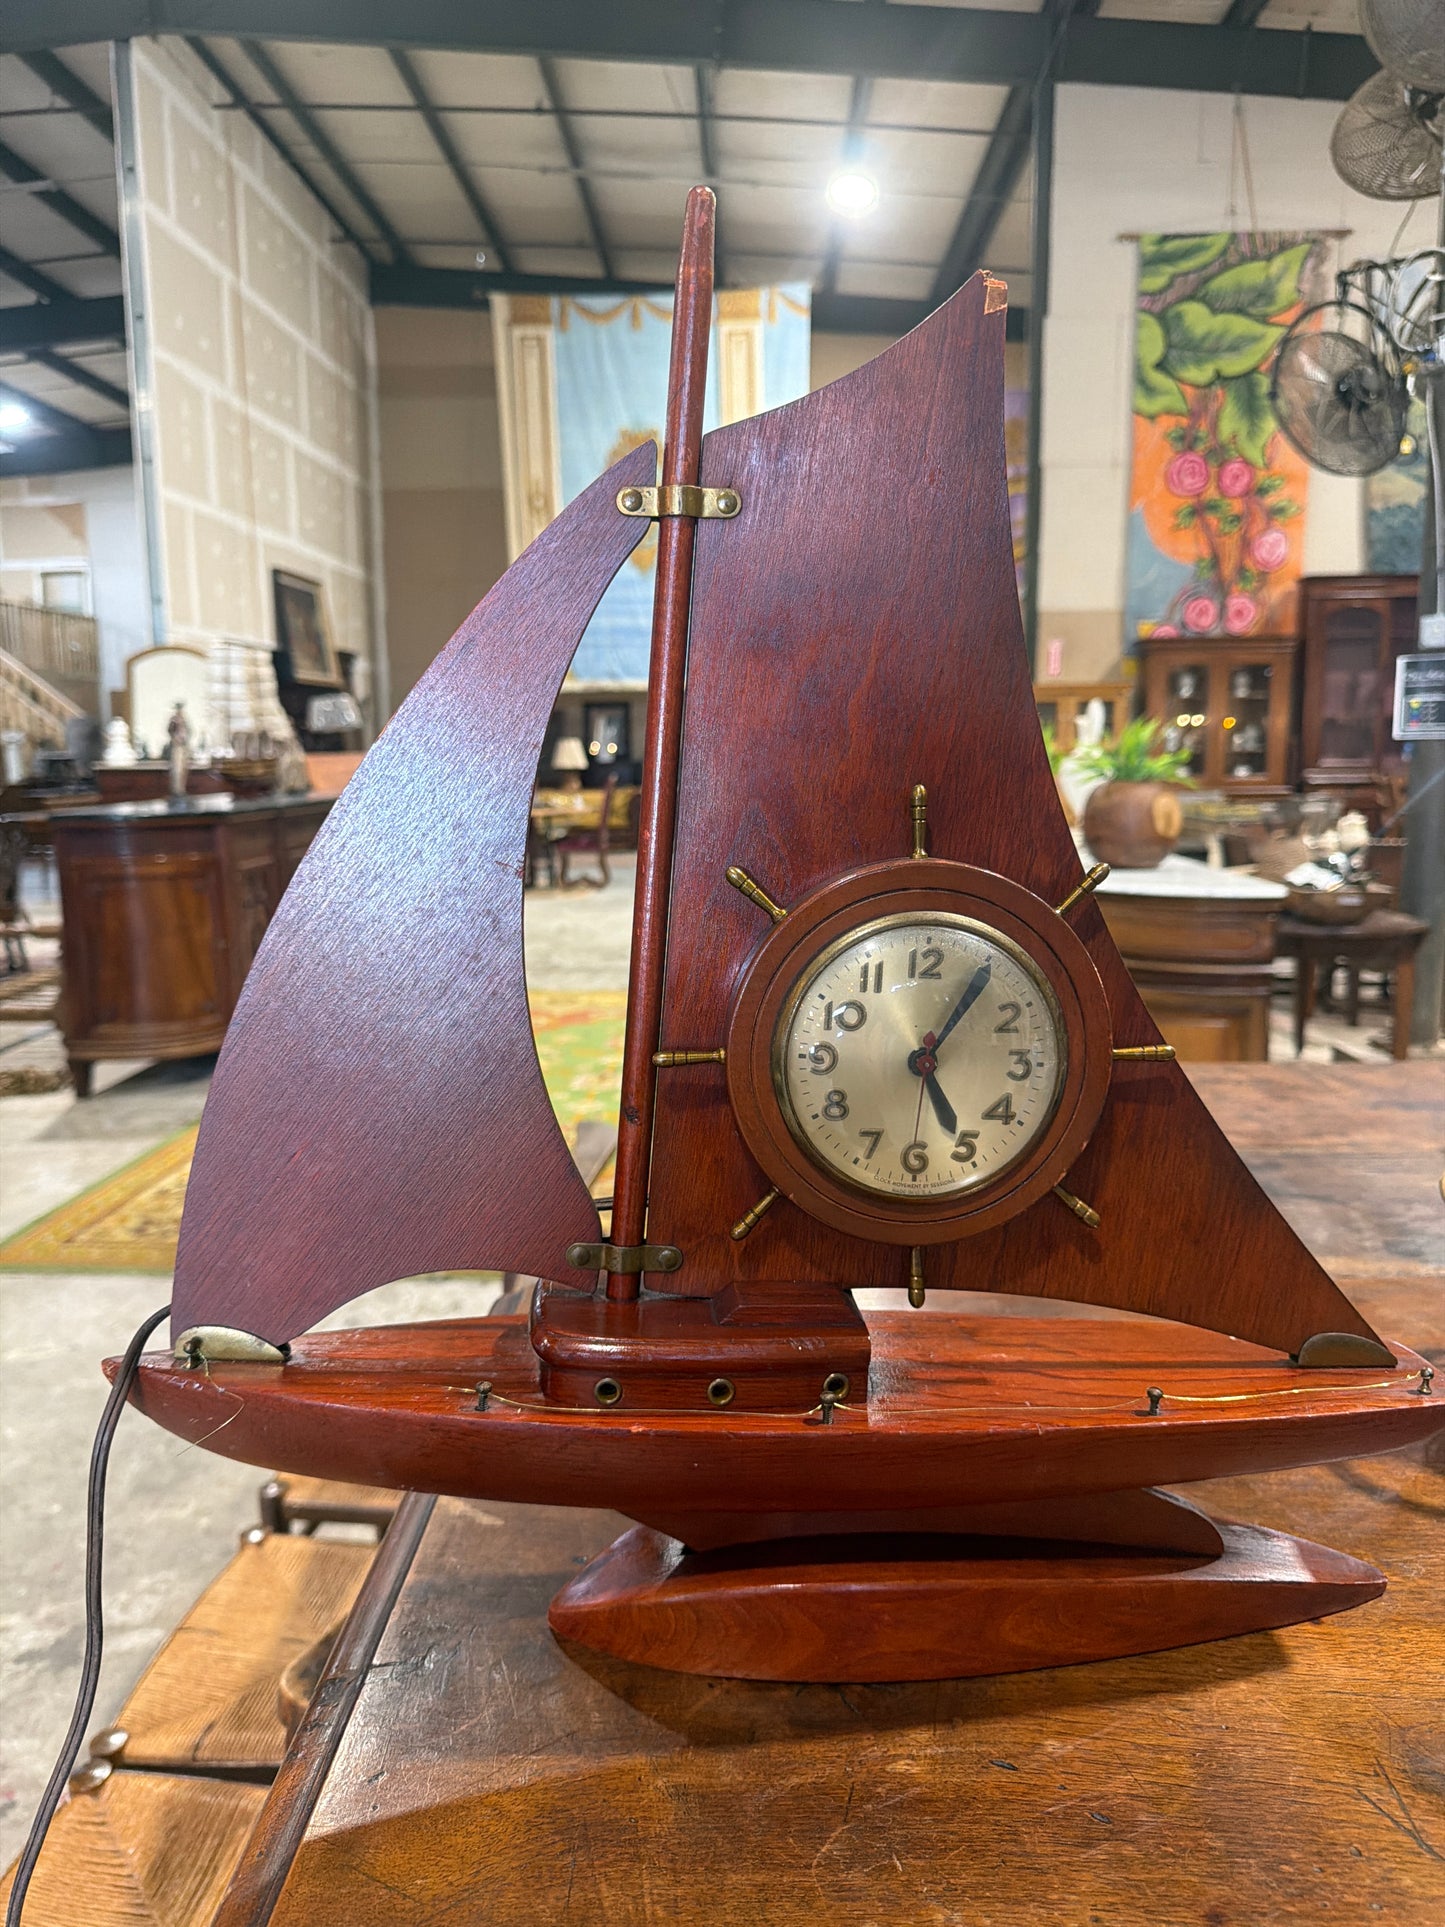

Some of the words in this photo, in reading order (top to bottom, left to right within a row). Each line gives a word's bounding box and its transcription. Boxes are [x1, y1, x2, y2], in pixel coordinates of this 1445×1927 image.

[859, 961, 884, 993] 11
[908, 947, 944, 979] 12
[823, 1000, 867, 1031] 10
[994, 1001, 1021, 1033] 2
[808, 1041, 838, 1075] 9
[1006, 1049, 1032, 1081] 3
[821, 1089, 849, 1121] 8
[981, 1092, 1017, 1125] 4
[859, 1127, 884, 1159] 7
[900, 1140, 929, 1175] 6
[950, 1129, 980, 1163] 5
[874, 1175, 890, 1184] CLOCK
[892, 1181, 922, 1189] MOVEMENT
[930, 1178, 956, 1188] SESSIONS
